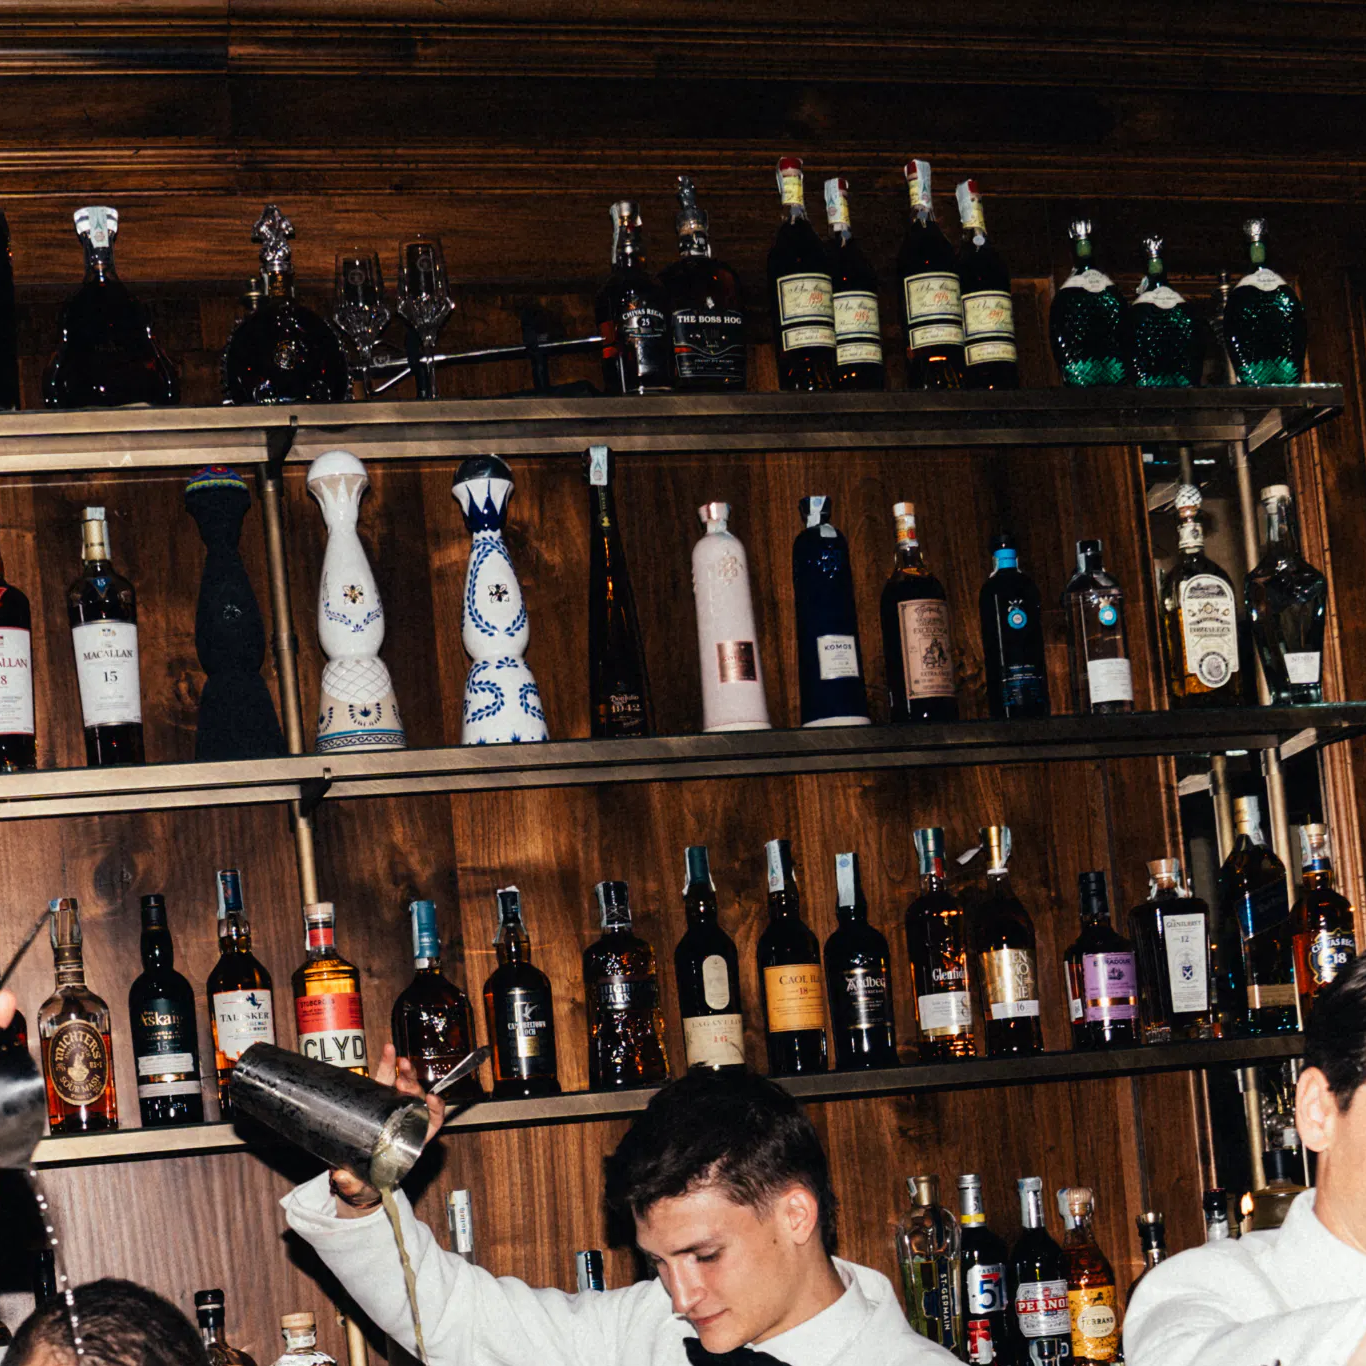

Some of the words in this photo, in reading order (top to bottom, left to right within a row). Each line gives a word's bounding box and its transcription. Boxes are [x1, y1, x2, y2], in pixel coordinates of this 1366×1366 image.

[622, 308, 646, 320] CHIVAS
[677, 315, 696, 323] THE
[698, 315, 722, 324] BOSS
[724, 316, 742, 324] HOG
[641, 318, 650, 326] 25
[824, 643, 853, 651] KOMOS
[83, 650, 134, 661] MACALLAN
[103, 670, 118, 683] 15
[1180, 936, 1189, 944] 12
[1093, 957, 1132, 967] ERADOUR
[779, 973, 808, 985] CAOL
[845, 975, 886, 991] Adbeg
[799, 986, 809, 995] 18
[220, 1012, 269, 1023] TALSKER
[507, 1021, 546, 1030] CAMBELTOWN
[156, 1041, 169, 1052] 15
[60, 1075, 81, 1093] SOUR
[81, 1074, 102, 1093] MASH
[978, 1278, 1005, 1310] 51
[940, 1273, 951, 1331] ST-GERMAIN
